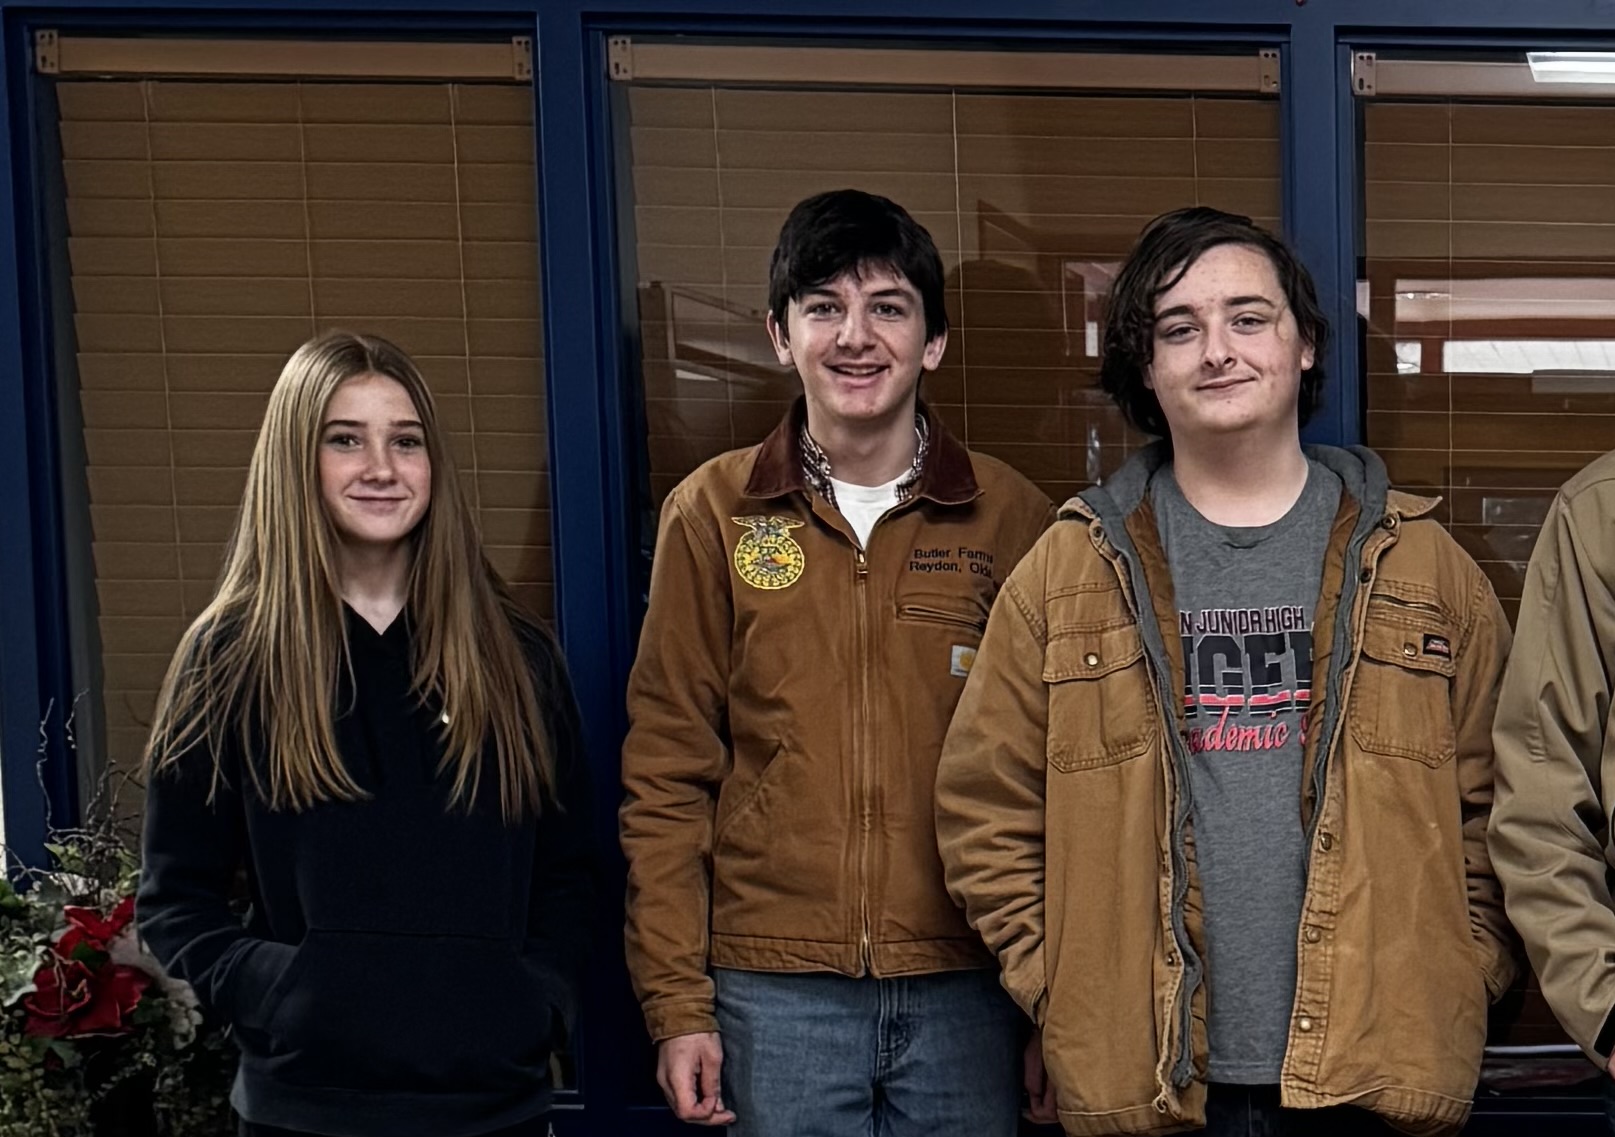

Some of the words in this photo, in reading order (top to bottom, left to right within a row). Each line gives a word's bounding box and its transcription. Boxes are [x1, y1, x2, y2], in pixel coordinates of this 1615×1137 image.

[914, 548, 951, 559] Butler
[1196, 608, 1263, 634] JUNIOR
[1265, 605, 1305, 632] HIGH
[1188, 706, 1290, 754] ademic
